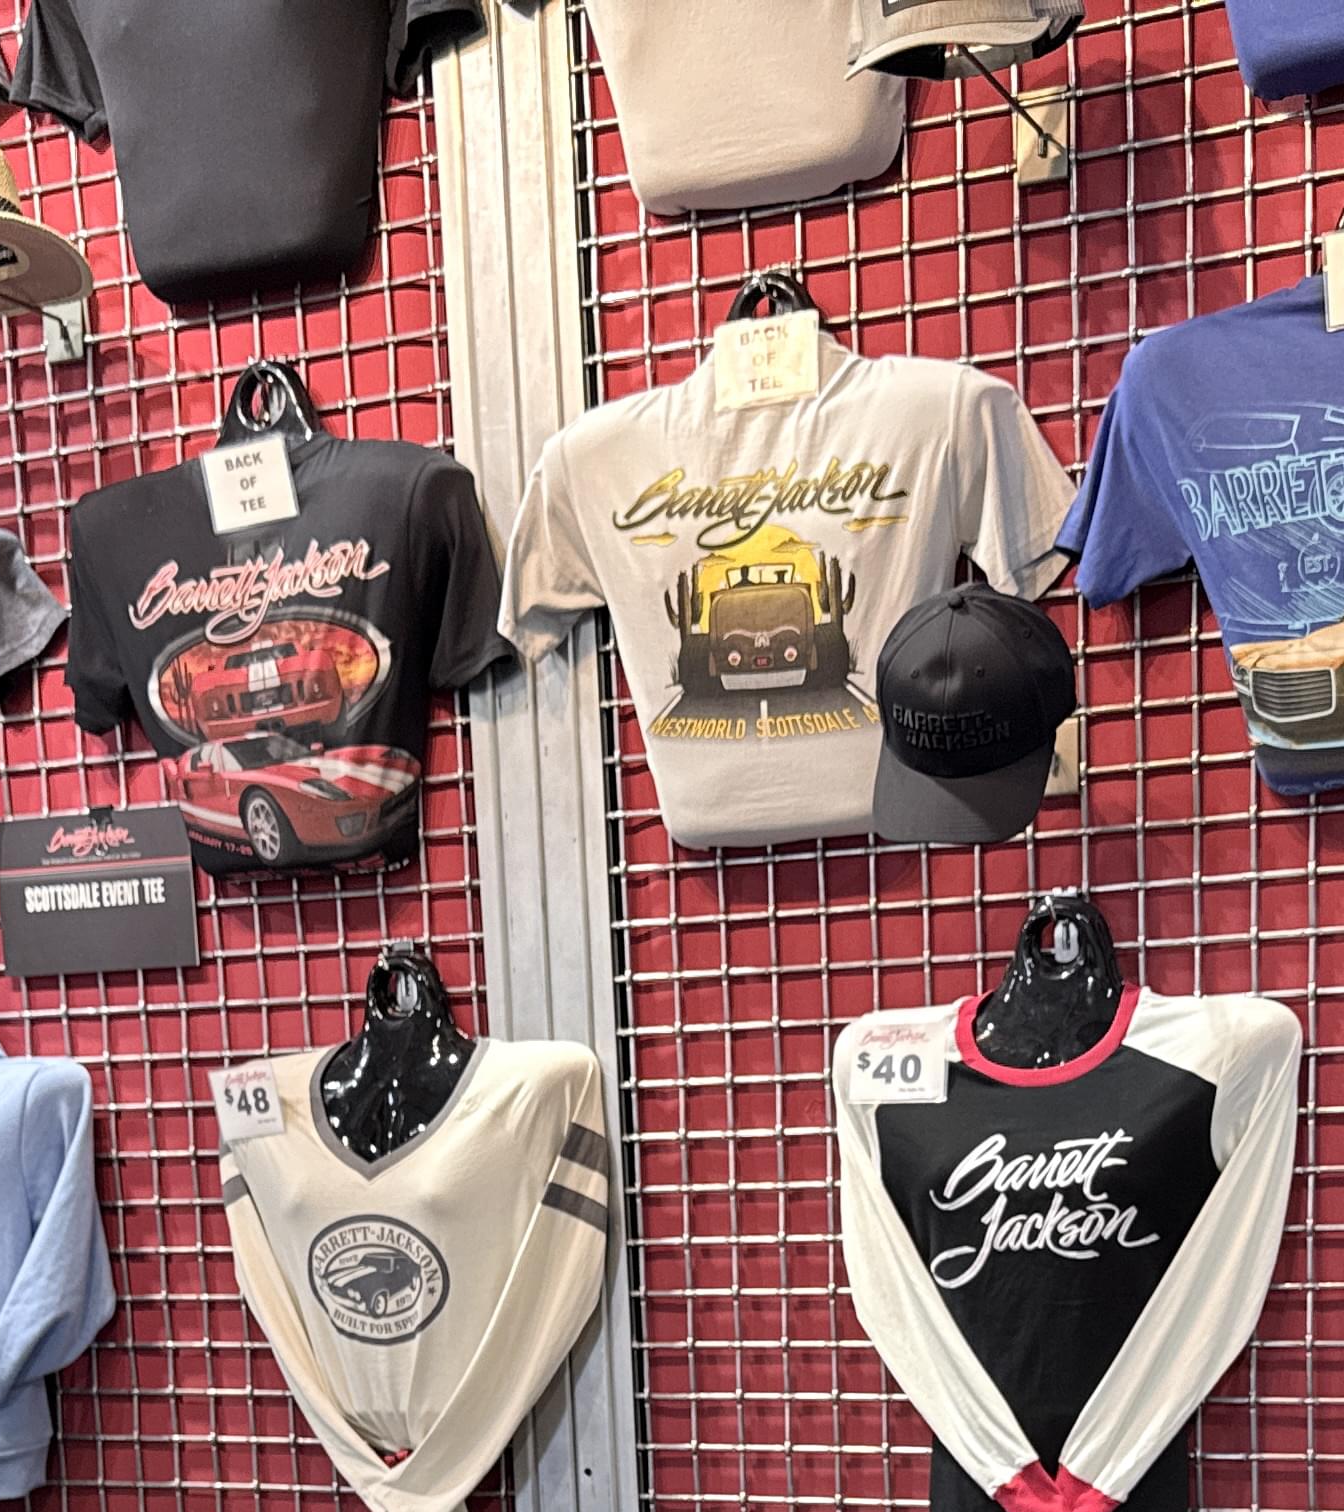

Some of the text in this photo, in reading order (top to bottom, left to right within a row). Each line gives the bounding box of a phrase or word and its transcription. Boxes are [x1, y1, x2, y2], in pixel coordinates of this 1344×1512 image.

[225, 452, 264, 472] BACK
[240, 476, 257, 490] OF
[240, 496, 266, 513] TEE
[613, 457, 907, 550] Barrett-Jackson
[1304, 554, 1335, 574] EST.
[127, 536, 391, 645] Barrett-Jackson
[651, 717, 746, 739] WESTWORLD
[756, 708, 861, 738] SCOTTSDALE
[906, 721, 1011, 750] JACKSON
[24, 876, 167, 914] SCOTTSDALE EVENT TEE
[857, 1051, 922, 1084] $40
[224, 1087, 270, 1116] $48
[930, 1128, 1134, 1211] Barrett-
[930, 1194, 1160, 1290] Jackson
[334, 1310, 368, 1331] BUILT
[369, 1323, 392, 1334] FOR
